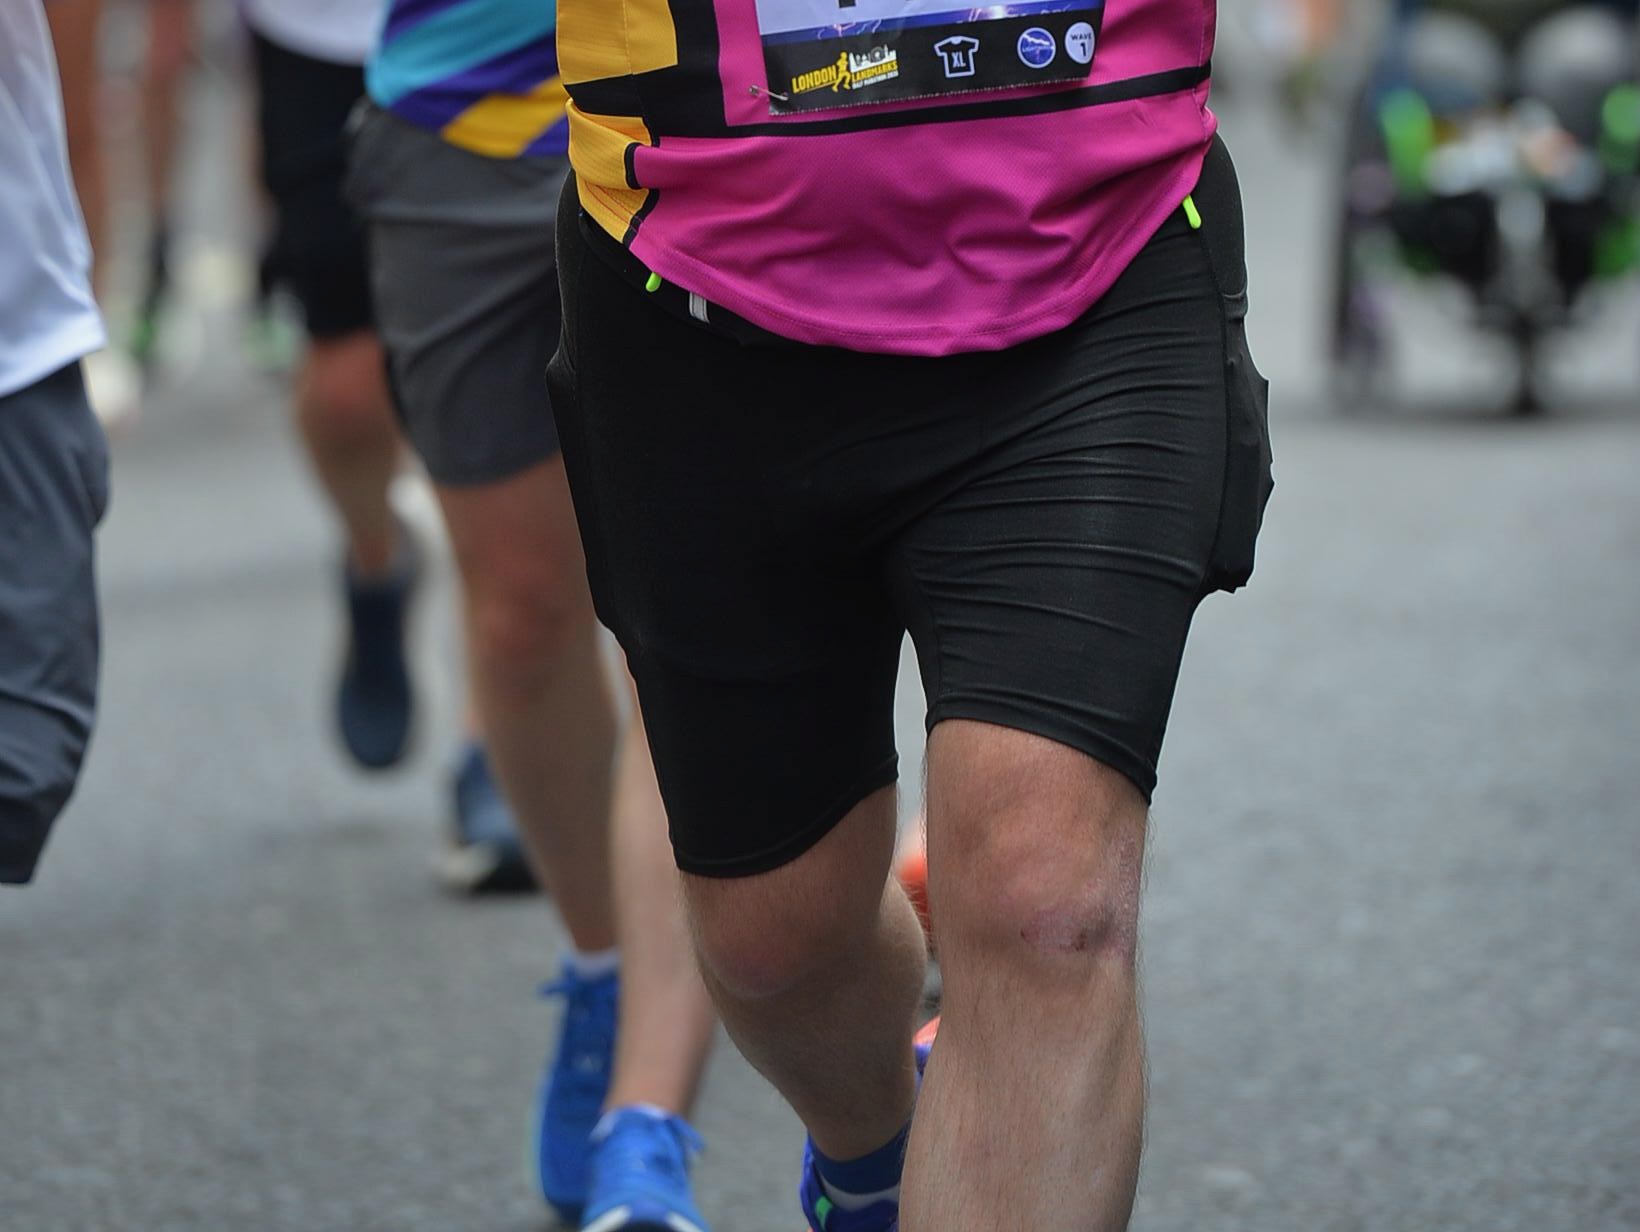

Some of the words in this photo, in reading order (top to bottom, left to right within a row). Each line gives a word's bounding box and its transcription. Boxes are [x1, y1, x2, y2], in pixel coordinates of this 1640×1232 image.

[1071, 32, 1092, 41] WAVE
[1080, 42, 1087, 57] 1
[951, 52, 967, 67] XL
[791, 65, 837, 94] LONDON
[851, 60, 898, 82] LANDMARKS
